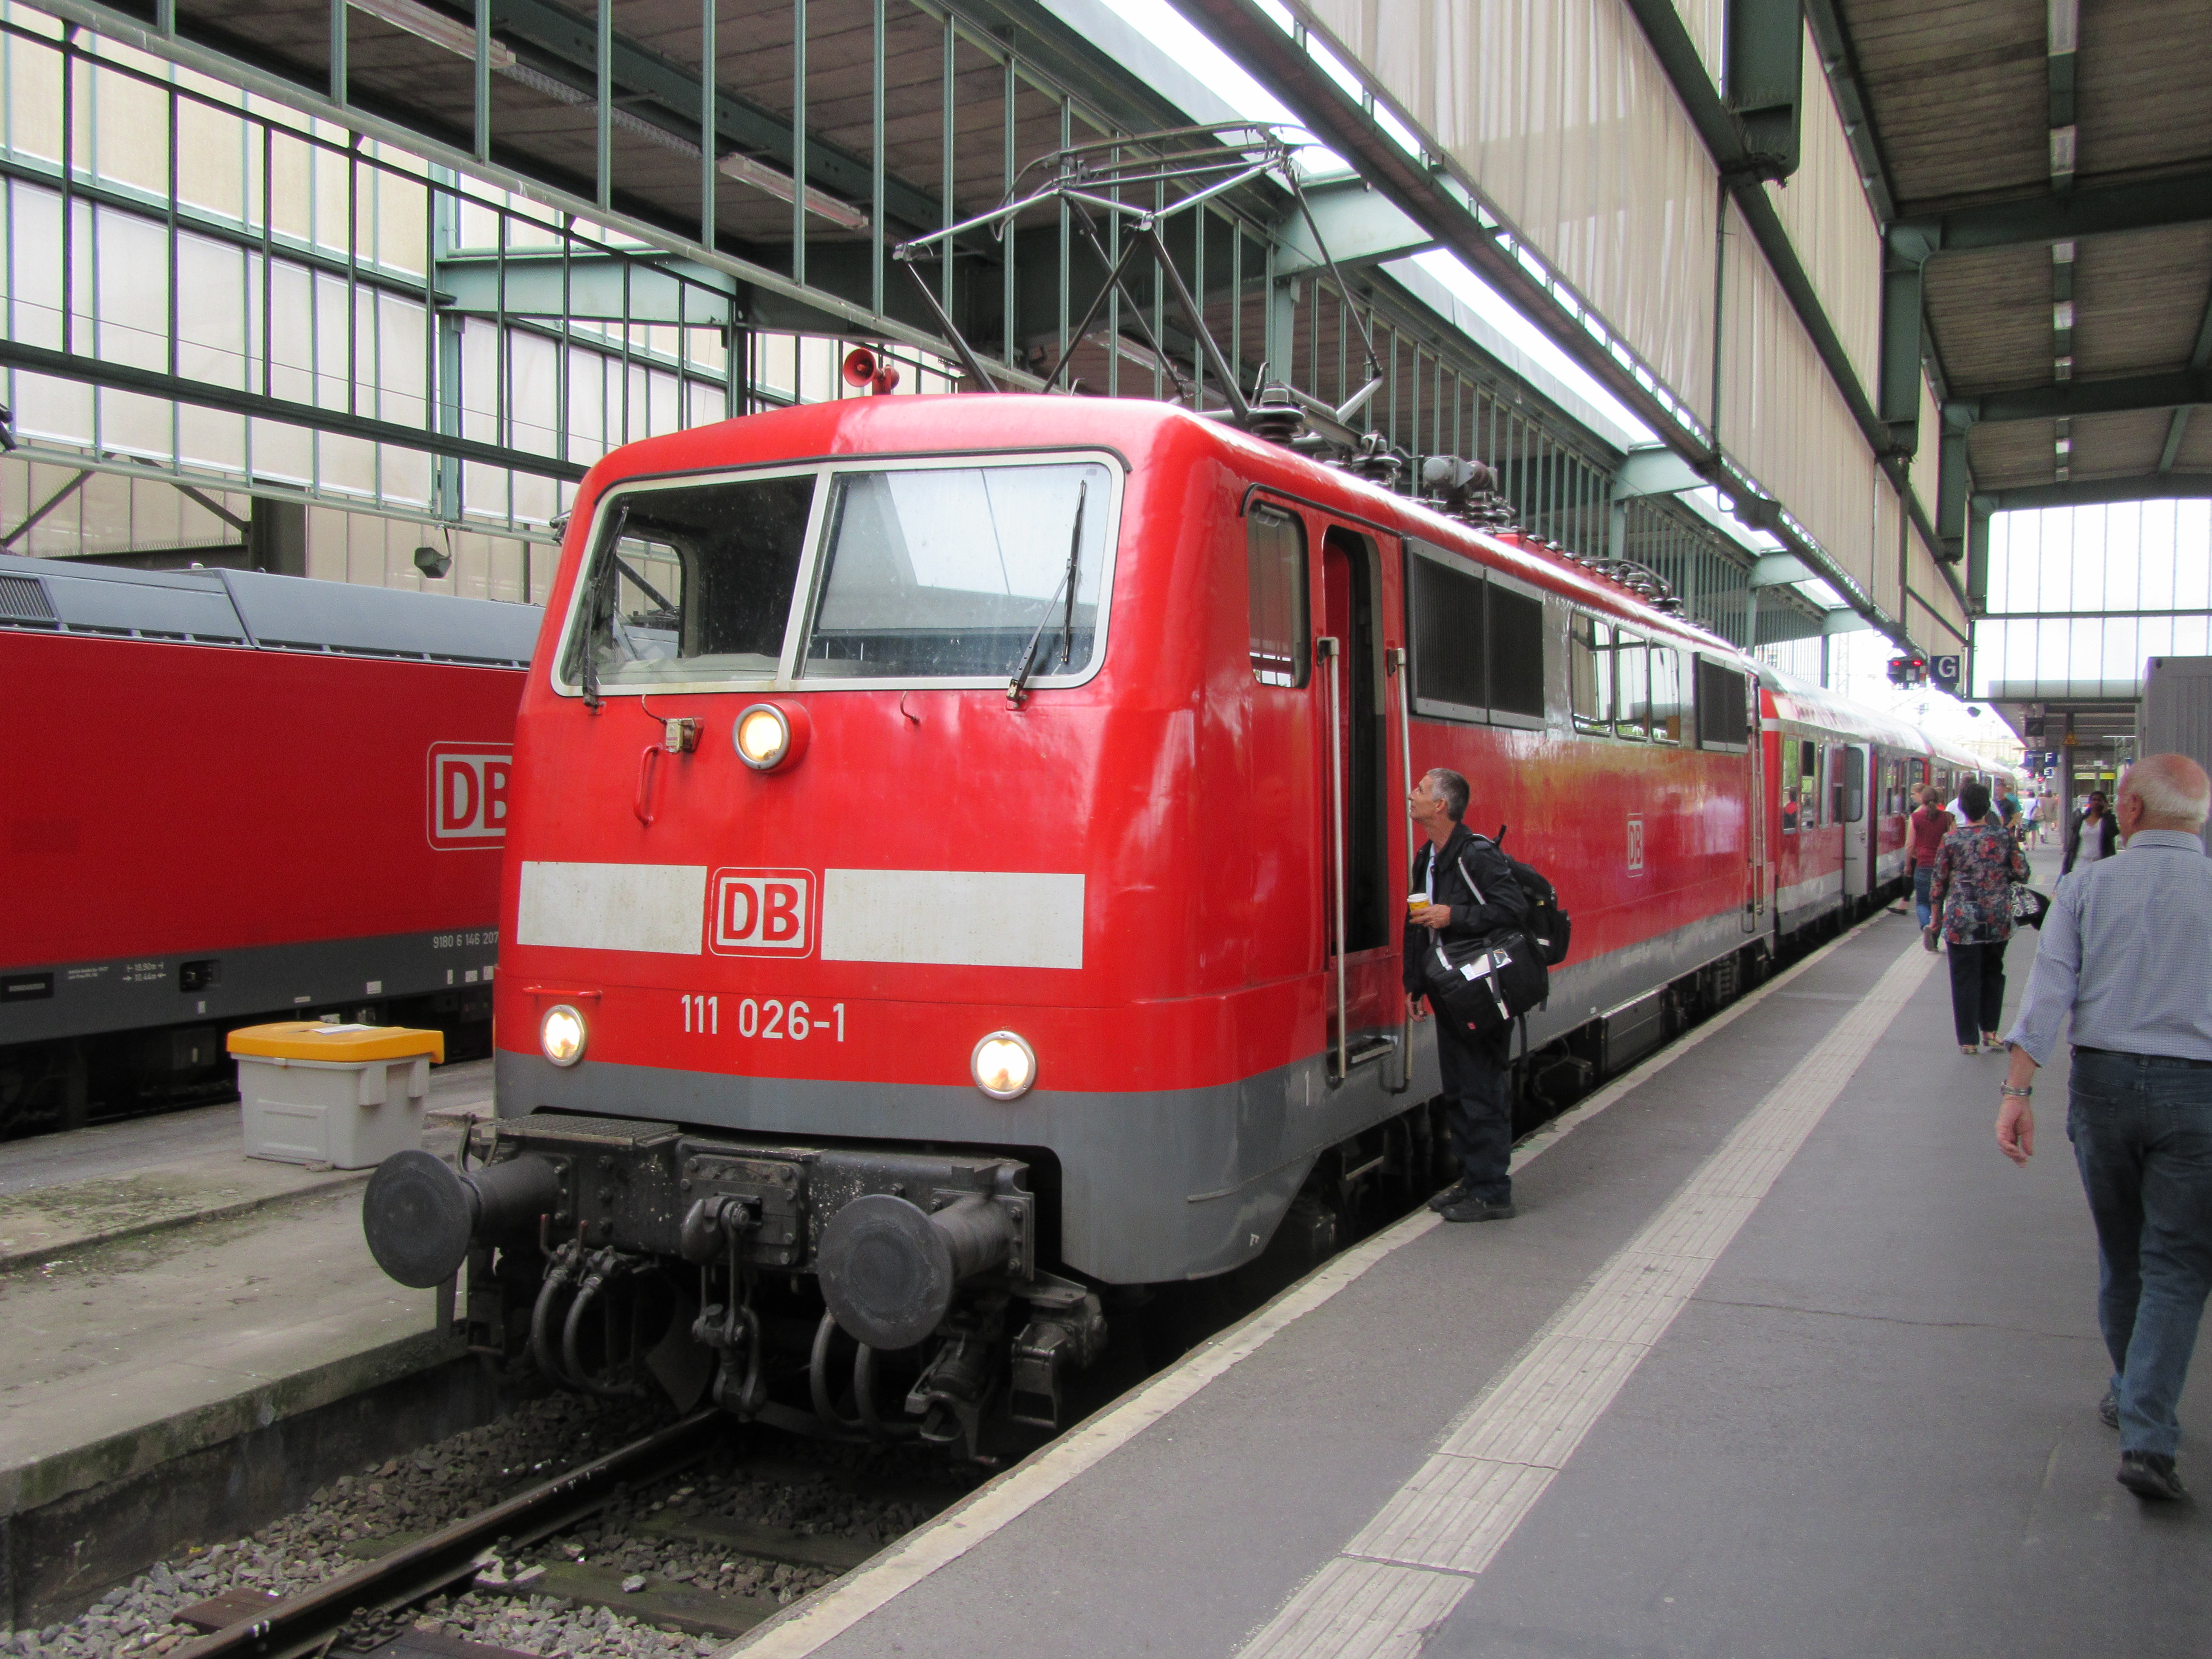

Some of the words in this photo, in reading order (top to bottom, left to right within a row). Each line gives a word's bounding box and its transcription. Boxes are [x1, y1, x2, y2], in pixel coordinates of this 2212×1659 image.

[1938, 656, 1956, 678] G
[2045, 752, 2052, 763] F
[442, 760, 512, 830] DB
[1628, 824, 1642, 866] DB
[722, 882, 800, 941] DB
[433, 935, 454, 949] 9180
[456, 934, 463, 946] 6
[466, 933, 480, 946] 146
[483, 931, 499, 945] 207
[681, 994, 718, 1034] 111
[739, 998, 845, 1042] 026-1
